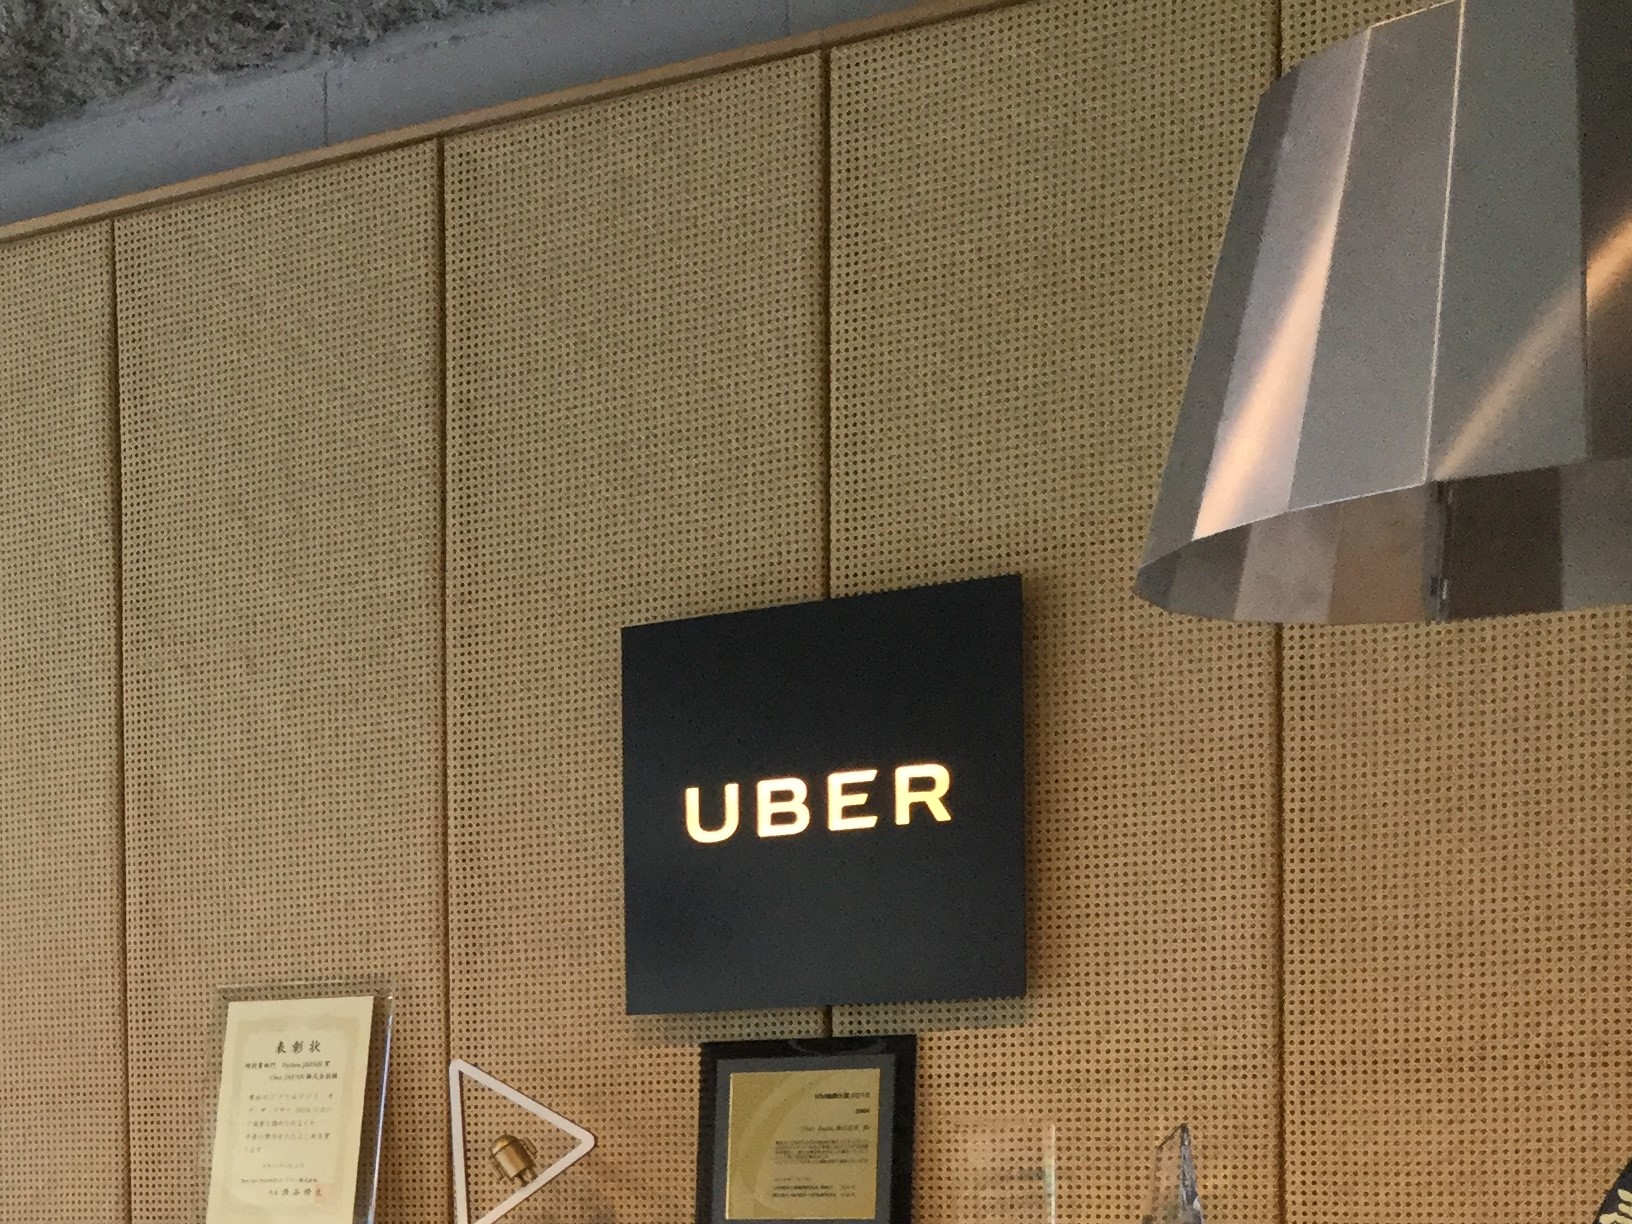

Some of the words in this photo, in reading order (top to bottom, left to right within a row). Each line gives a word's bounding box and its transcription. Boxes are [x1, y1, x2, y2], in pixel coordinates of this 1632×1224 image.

[684, 763, 953, 844] UBER
[275, 1040, 321, 1054] 表彰状
